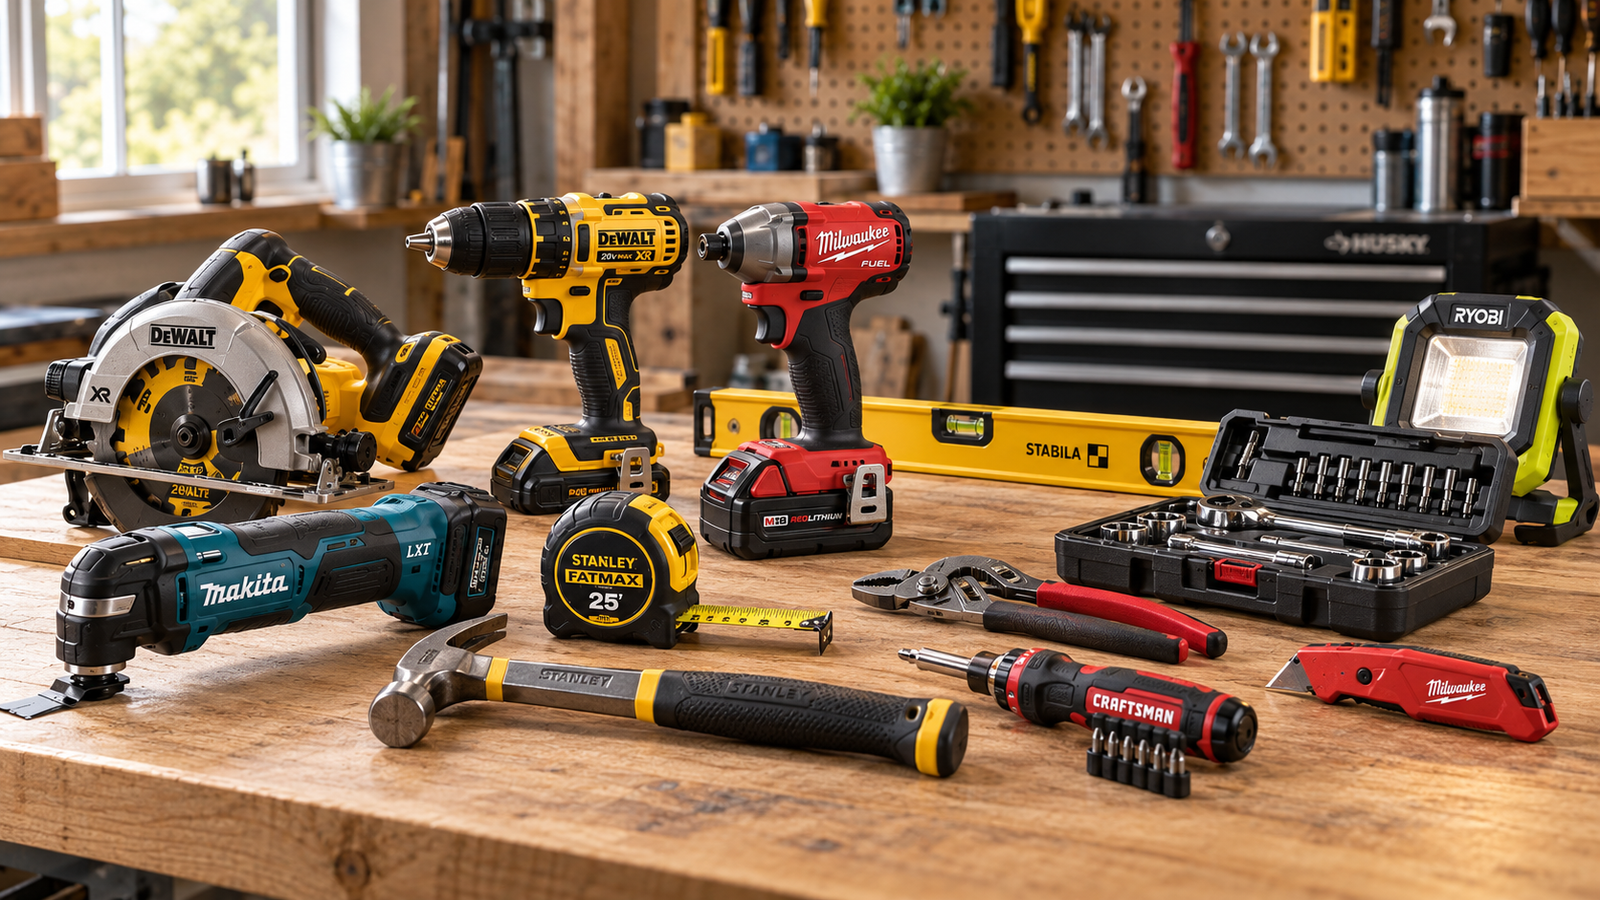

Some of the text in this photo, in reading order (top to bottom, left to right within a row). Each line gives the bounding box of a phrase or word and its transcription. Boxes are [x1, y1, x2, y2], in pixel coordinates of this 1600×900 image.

[815, 225, 890, 256] Milwaukee
[1352, 233, 1430, 255] HUSKY
[635, 250, 652, 261] XR
[861, 260, 891, 268] FUEL
[1454, 307, 1504, 326] RYOBI
[89, 386, 111, 404] XR
[1026, 442, 1081, 461] STABILA
[406, 542, 431, 558] LXT
[571, 553, 637, 570] STANLEY
[568, 571, 640, 586] FATMAX
[200, 572, 289, 607] Makita
[539, 668, 613, 688] STANLEY
[1425, 678, 1487, 697] Milwaukee
[730, 682, 812, 700] STANLEY
[1092, 693, 1175, 725] CRAFTSMAN
